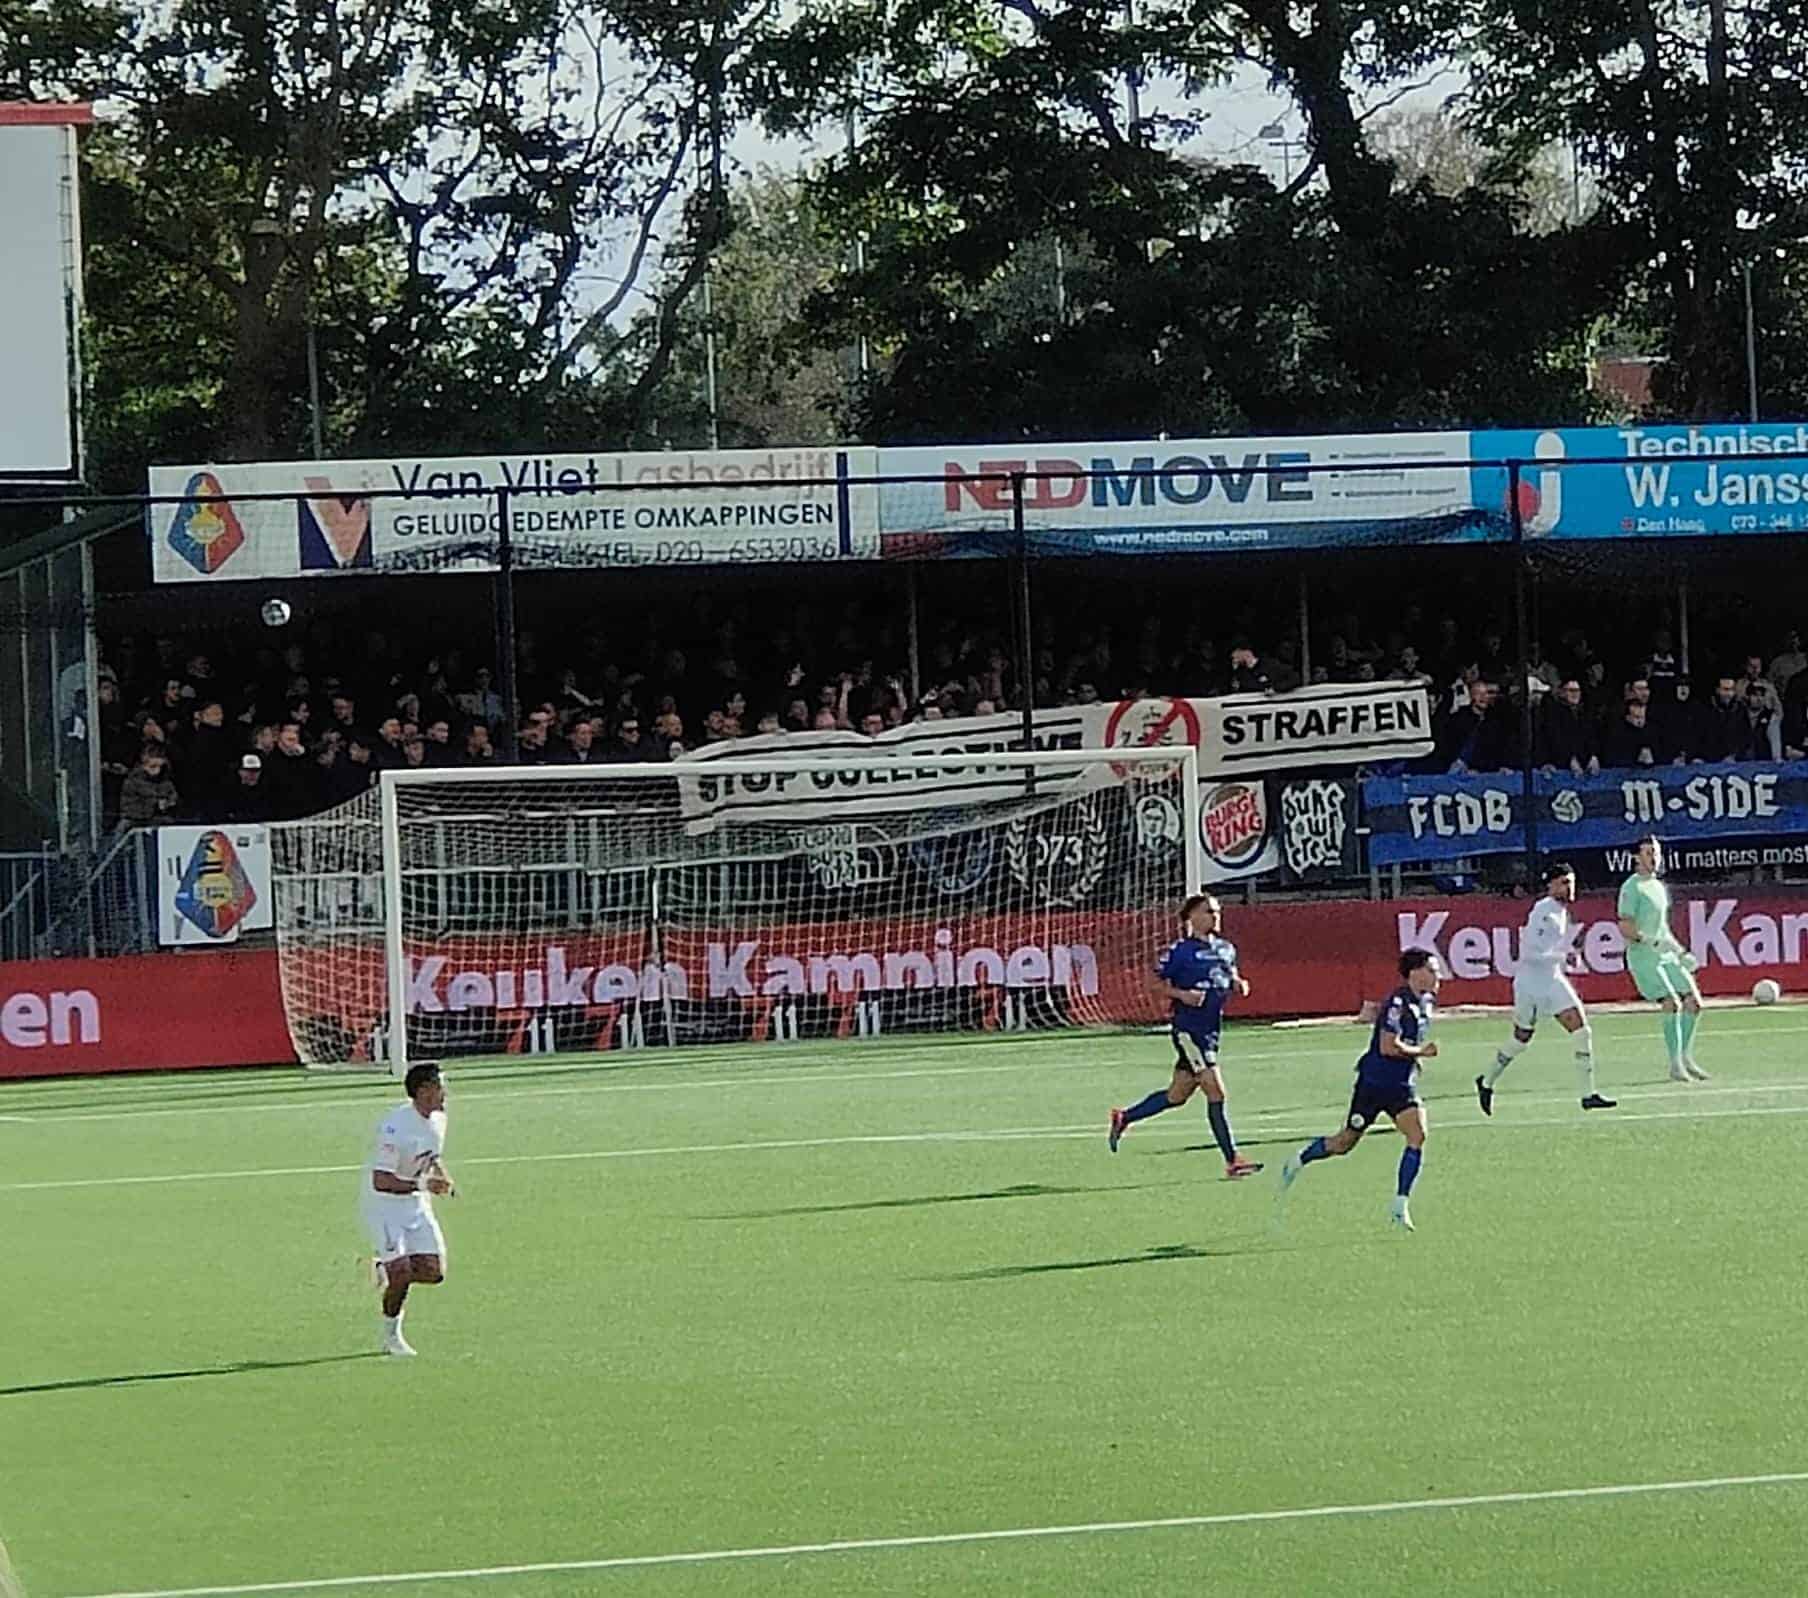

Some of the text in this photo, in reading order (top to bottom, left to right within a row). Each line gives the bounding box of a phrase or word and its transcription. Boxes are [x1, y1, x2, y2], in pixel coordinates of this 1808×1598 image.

[392, 463, 482, 499] Van
[500, 458, 599, 498] Vliet
[944, 452, 1313, 512] NEDMOVE
[1625, 464, 1679, 508] W.
[634, 504, 834, 528] OMKAPPINGEN
[1222, 700, 1423, 745] STRAFFEN
[1407, 789, 1512, 840] FCDB
[1686, 848, 1758, 868] matters
